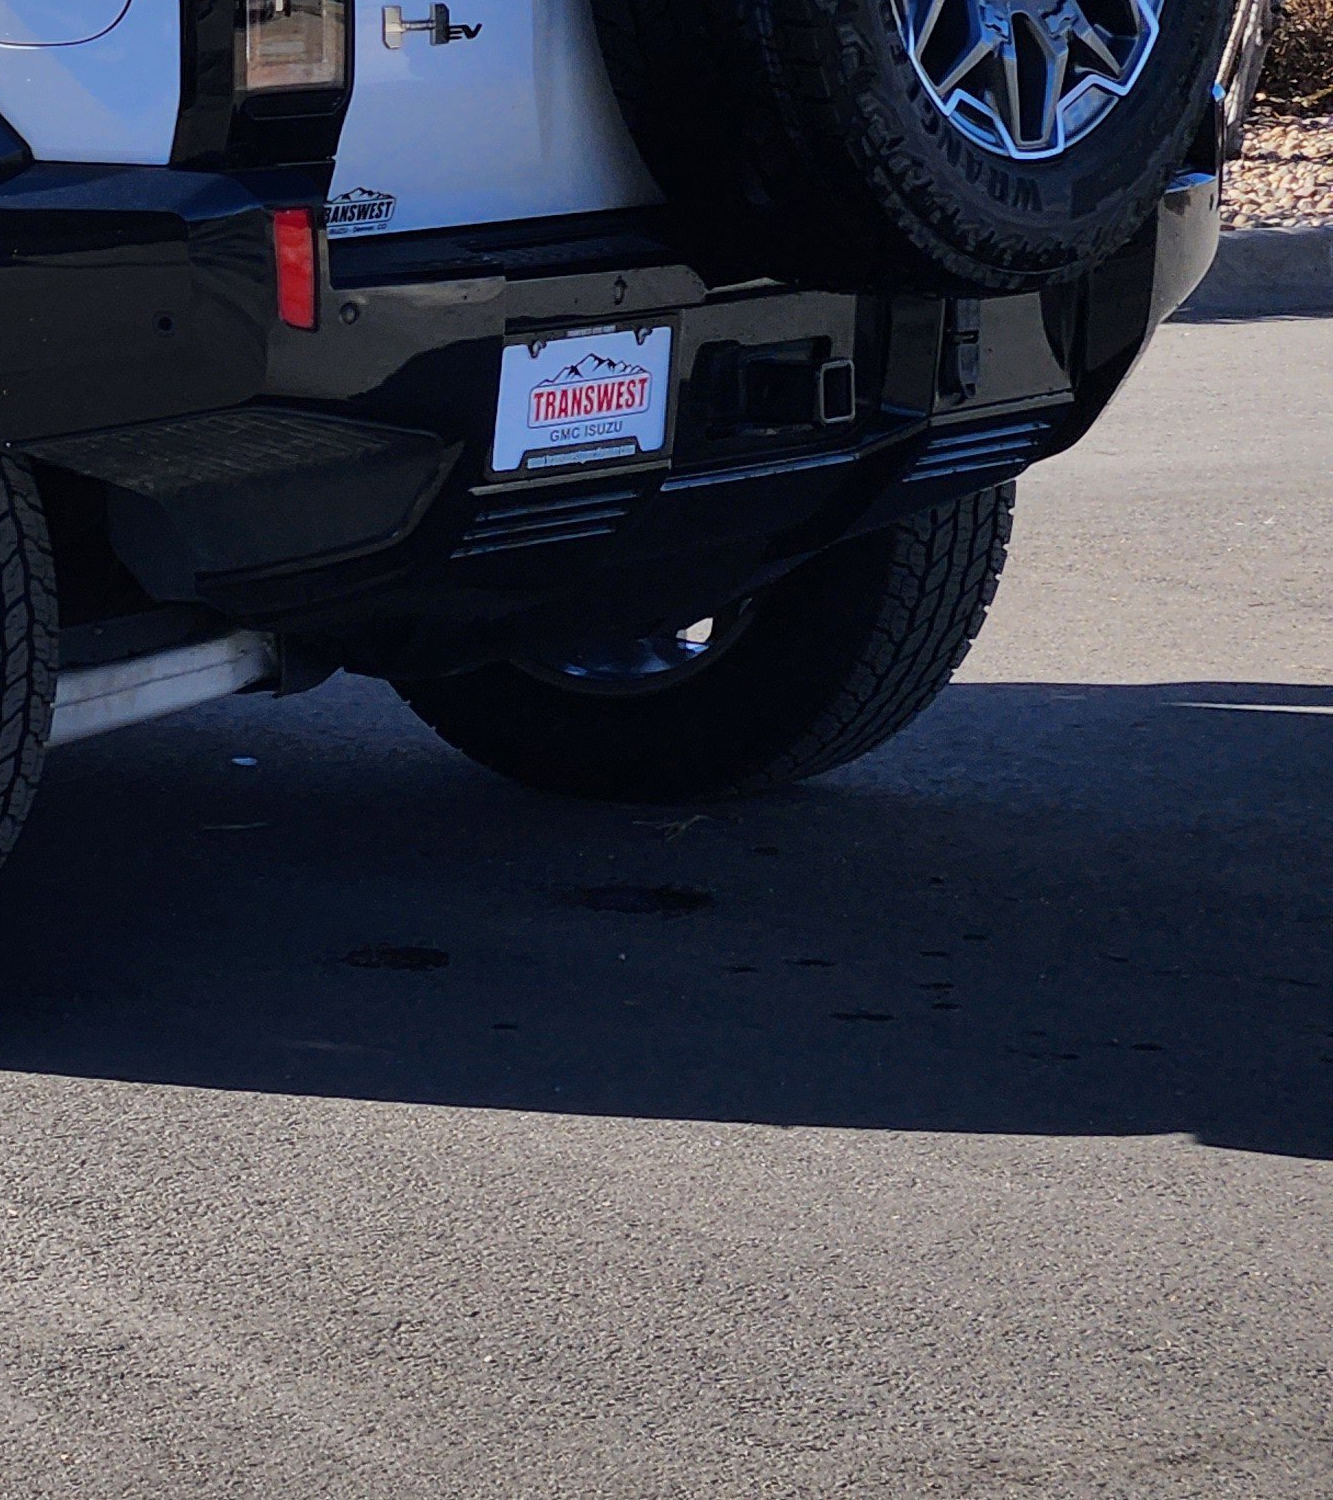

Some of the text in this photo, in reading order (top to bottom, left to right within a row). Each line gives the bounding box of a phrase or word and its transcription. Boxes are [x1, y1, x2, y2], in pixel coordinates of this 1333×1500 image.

[533, 376, 649, 422] TRANSWEST
[549, 420, 624, 443] GMC ISUZU
